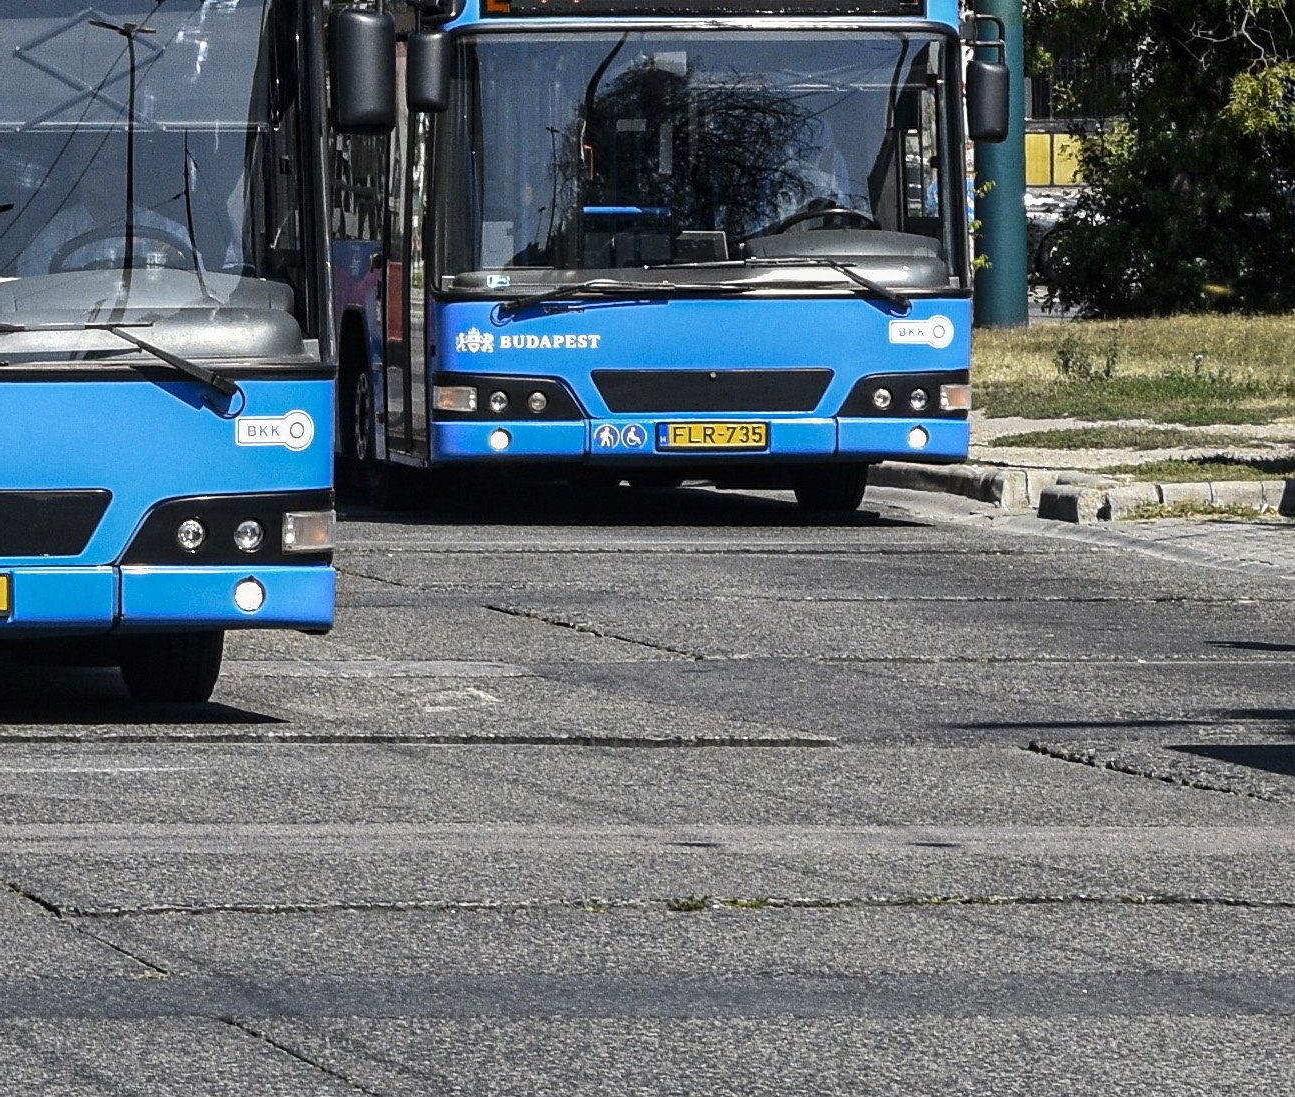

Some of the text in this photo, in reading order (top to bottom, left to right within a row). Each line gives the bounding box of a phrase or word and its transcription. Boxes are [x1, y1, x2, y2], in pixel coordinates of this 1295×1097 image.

[499, 334, 601, 349] BUDAPEST
[247, 425, 280, 437] BKK
[672, 426, 763, 445] FLR-735
